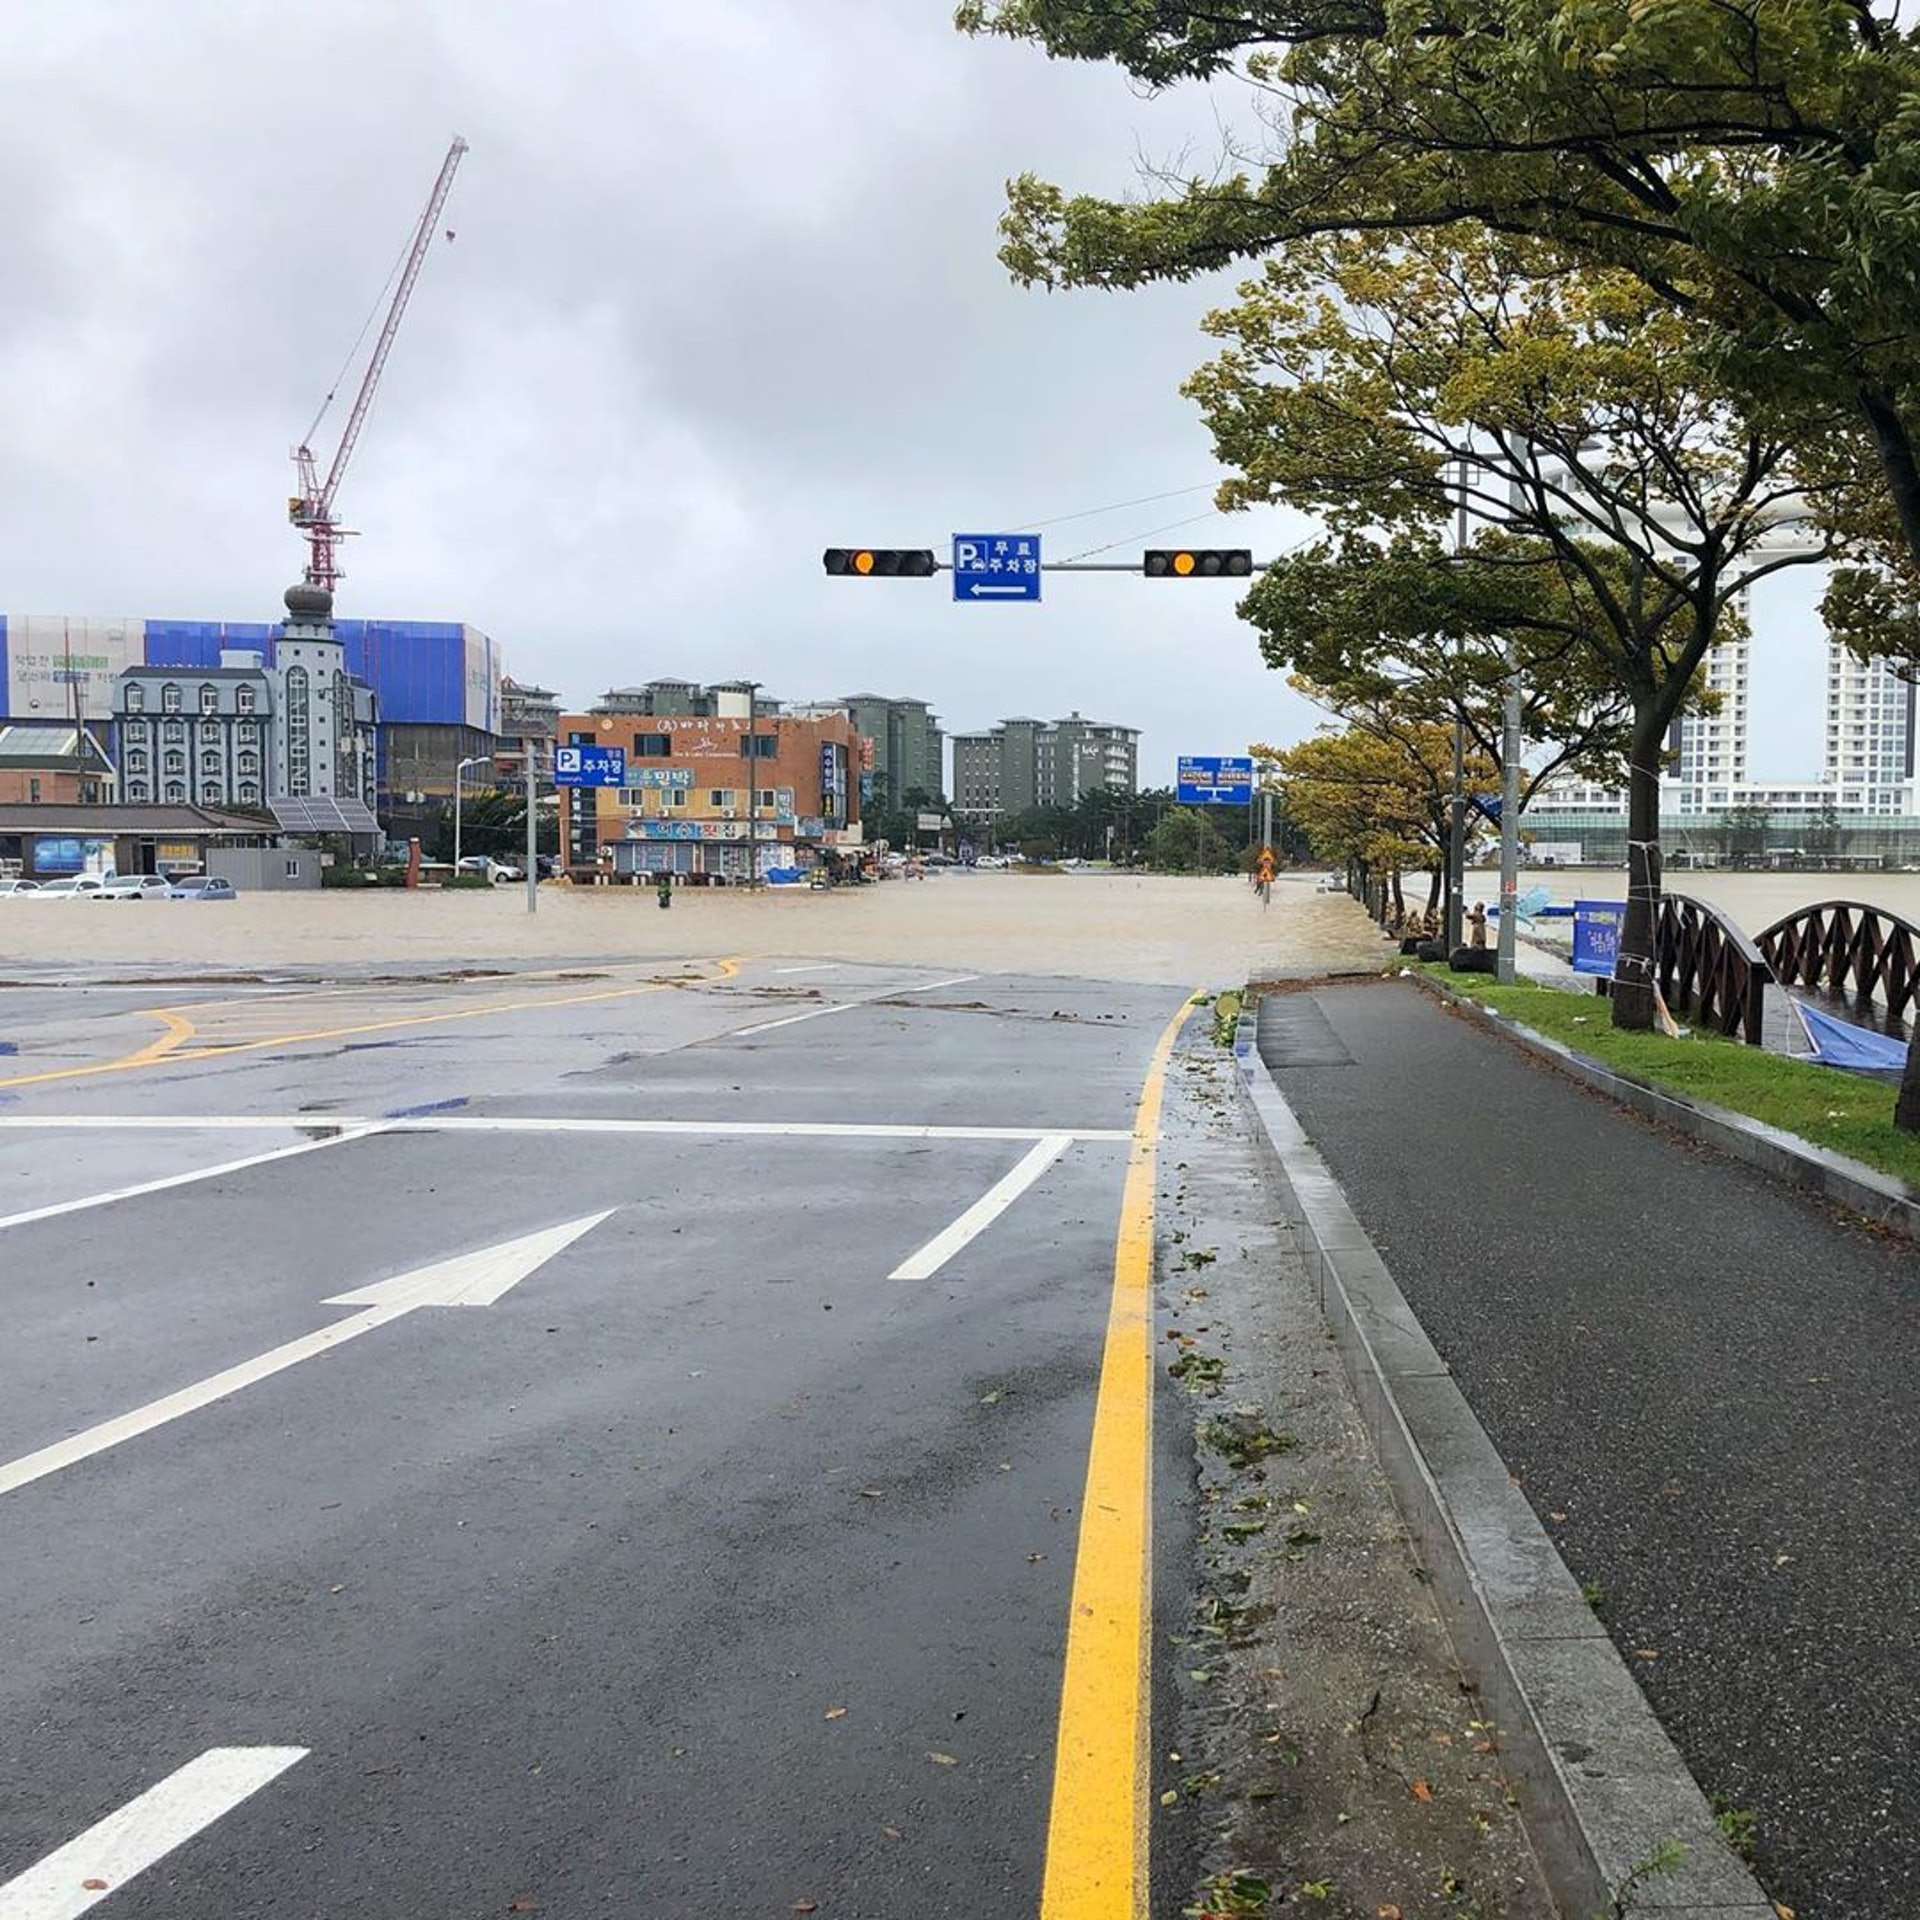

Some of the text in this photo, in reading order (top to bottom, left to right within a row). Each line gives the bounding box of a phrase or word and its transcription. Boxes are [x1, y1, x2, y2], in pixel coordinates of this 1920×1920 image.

[959, 543, 978, 569] P
[995, 541, 1031, 556] 무료
[989, 558, 1037, 574] 주차장
[560, 751, 574, 768] P
[582, 759, 621, 774] 주차장
[654, 769, 690, 786] 민박
